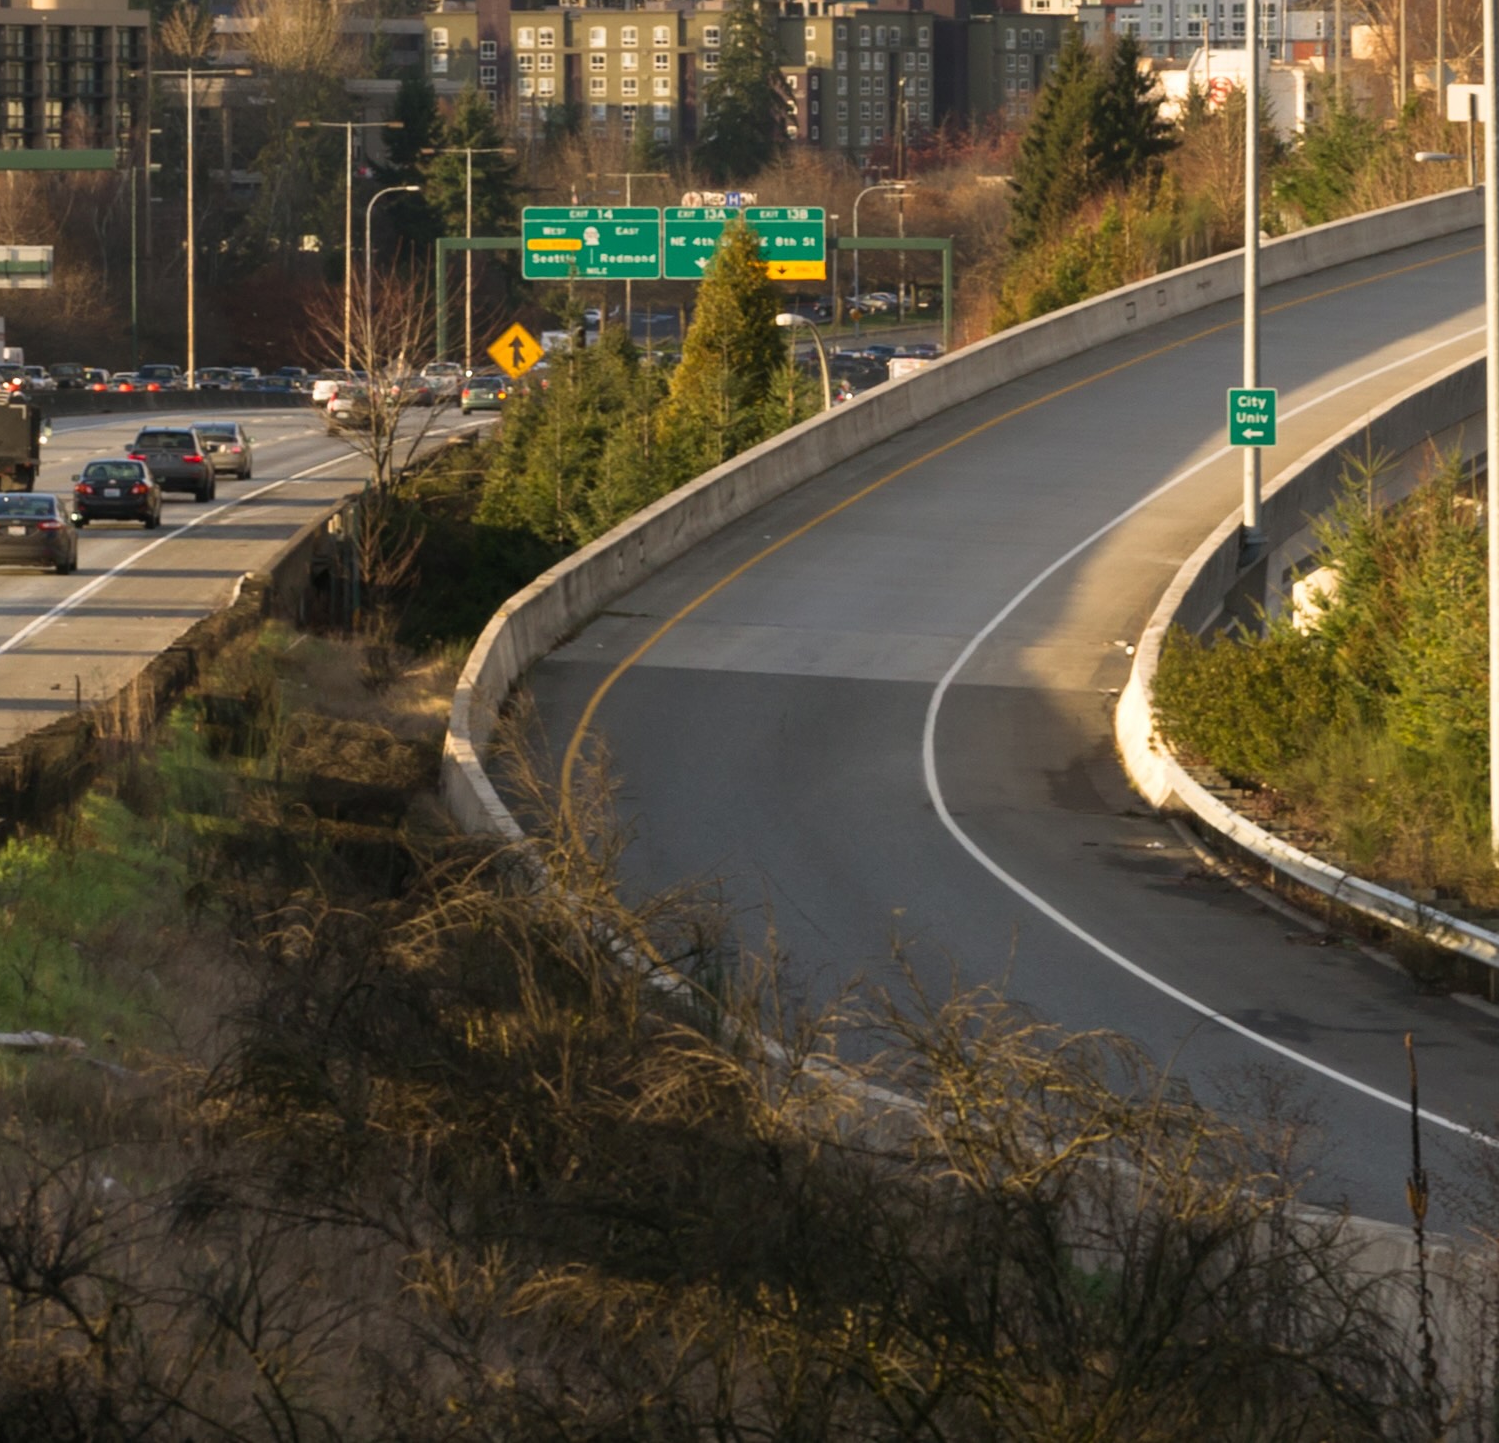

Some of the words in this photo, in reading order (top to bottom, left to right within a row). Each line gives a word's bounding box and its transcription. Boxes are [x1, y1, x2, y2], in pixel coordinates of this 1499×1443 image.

[569, 210, 589, 218] EXIT
[597, 209, 613, 219] 14
[677, 210, 695, 218] EXIT
[704, 209, 726, 219] 13A
[759, 210, 779, 218] EXIT
[786, 209, 809, 219] 13B
[670, 237, 686, 246] NE
[692, 237, 715, 246] 4th
[775, 237, 797, 246] 8th
[802, 237, 816, 246] St
[532, 253, 576, 263] Seattle
[600, 253, 656, 263] Redmond
[1237, 395, 1267, 410] City
[1236, 412, 1268, 423] Univ
